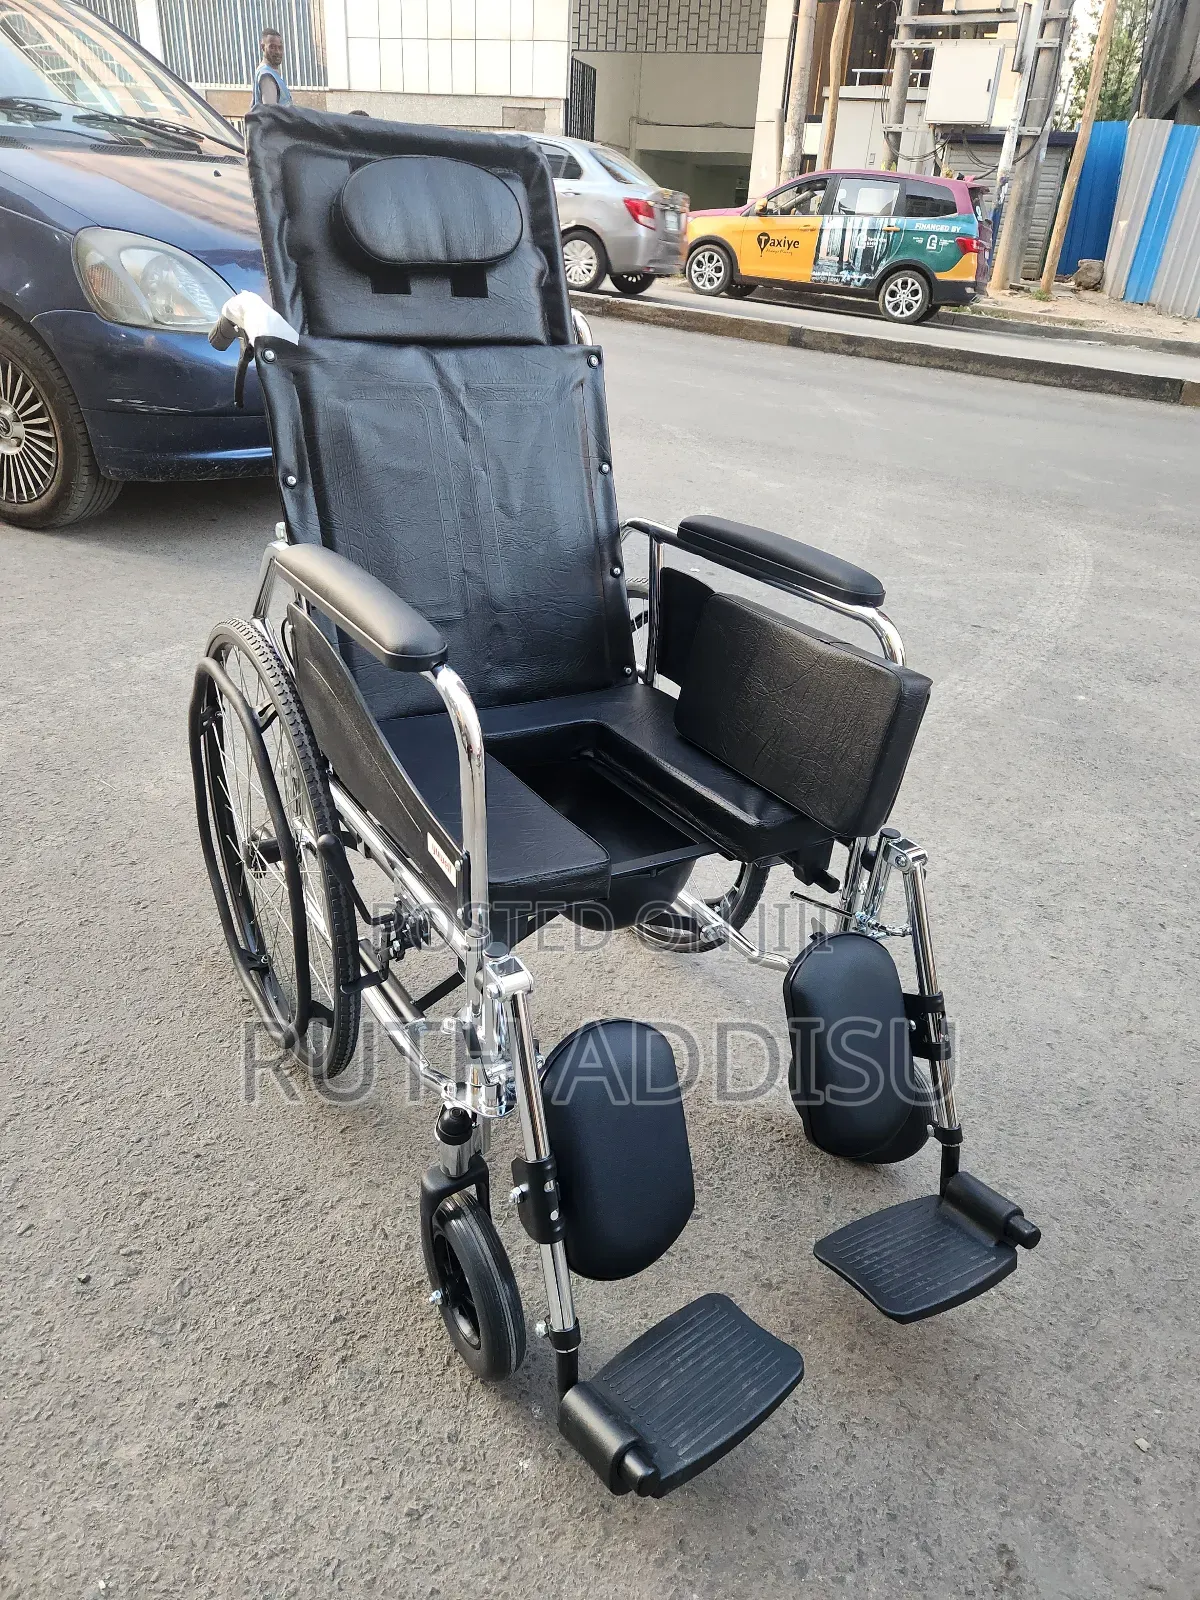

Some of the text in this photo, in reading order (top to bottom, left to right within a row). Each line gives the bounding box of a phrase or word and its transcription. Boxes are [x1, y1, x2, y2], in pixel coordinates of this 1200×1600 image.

[914, 222, 962, 233] FINANCED BY
[758, 234, 800, 251] Taxiye
